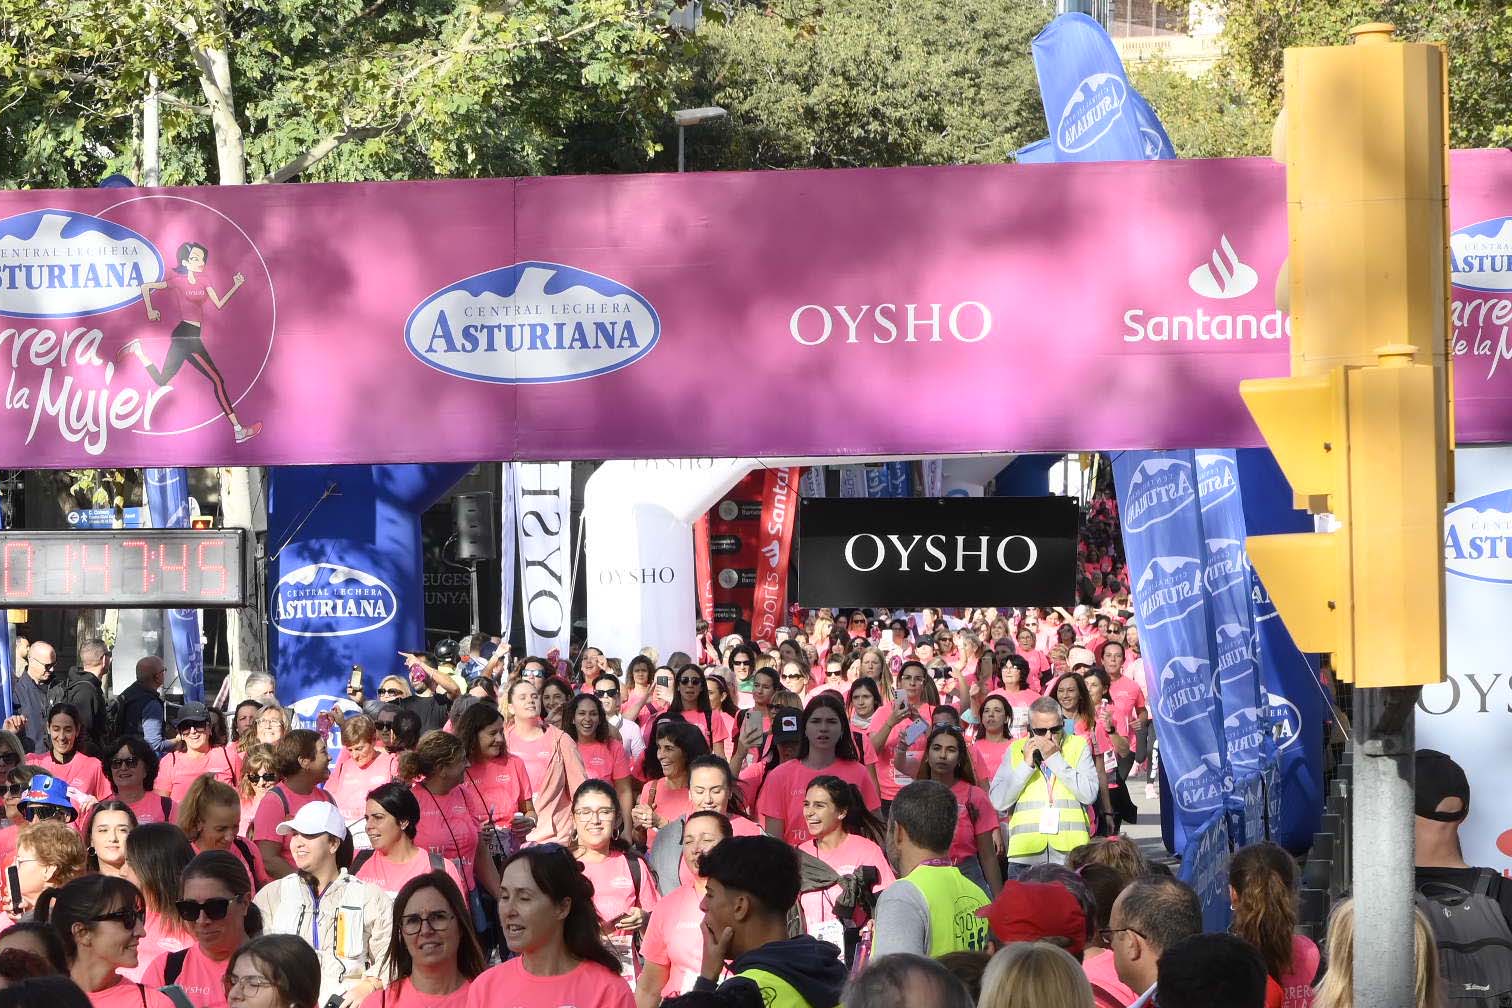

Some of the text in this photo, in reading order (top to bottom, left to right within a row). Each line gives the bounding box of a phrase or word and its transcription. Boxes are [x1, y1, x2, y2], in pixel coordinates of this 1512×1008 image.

[67, 245, 139, 257] LECHERA
[465, 302, 632, 317] CENTRAL LECHERA
[789, 301, 992, 346] OYSHO
[425, 309, 640, 354] ASTURIANA
[4, 370, 30, 411] la
[25, 362, 175, 456] Mujer
[844, 533, 1039, 574] OYSHO
[599, 566, 675, 585] OYSHO
[274, 593, 388, 620] ASTURIANA
[287, 588, 383, 598] CENTRAL LECHERA
[756, 572, 779, 640] Sports
